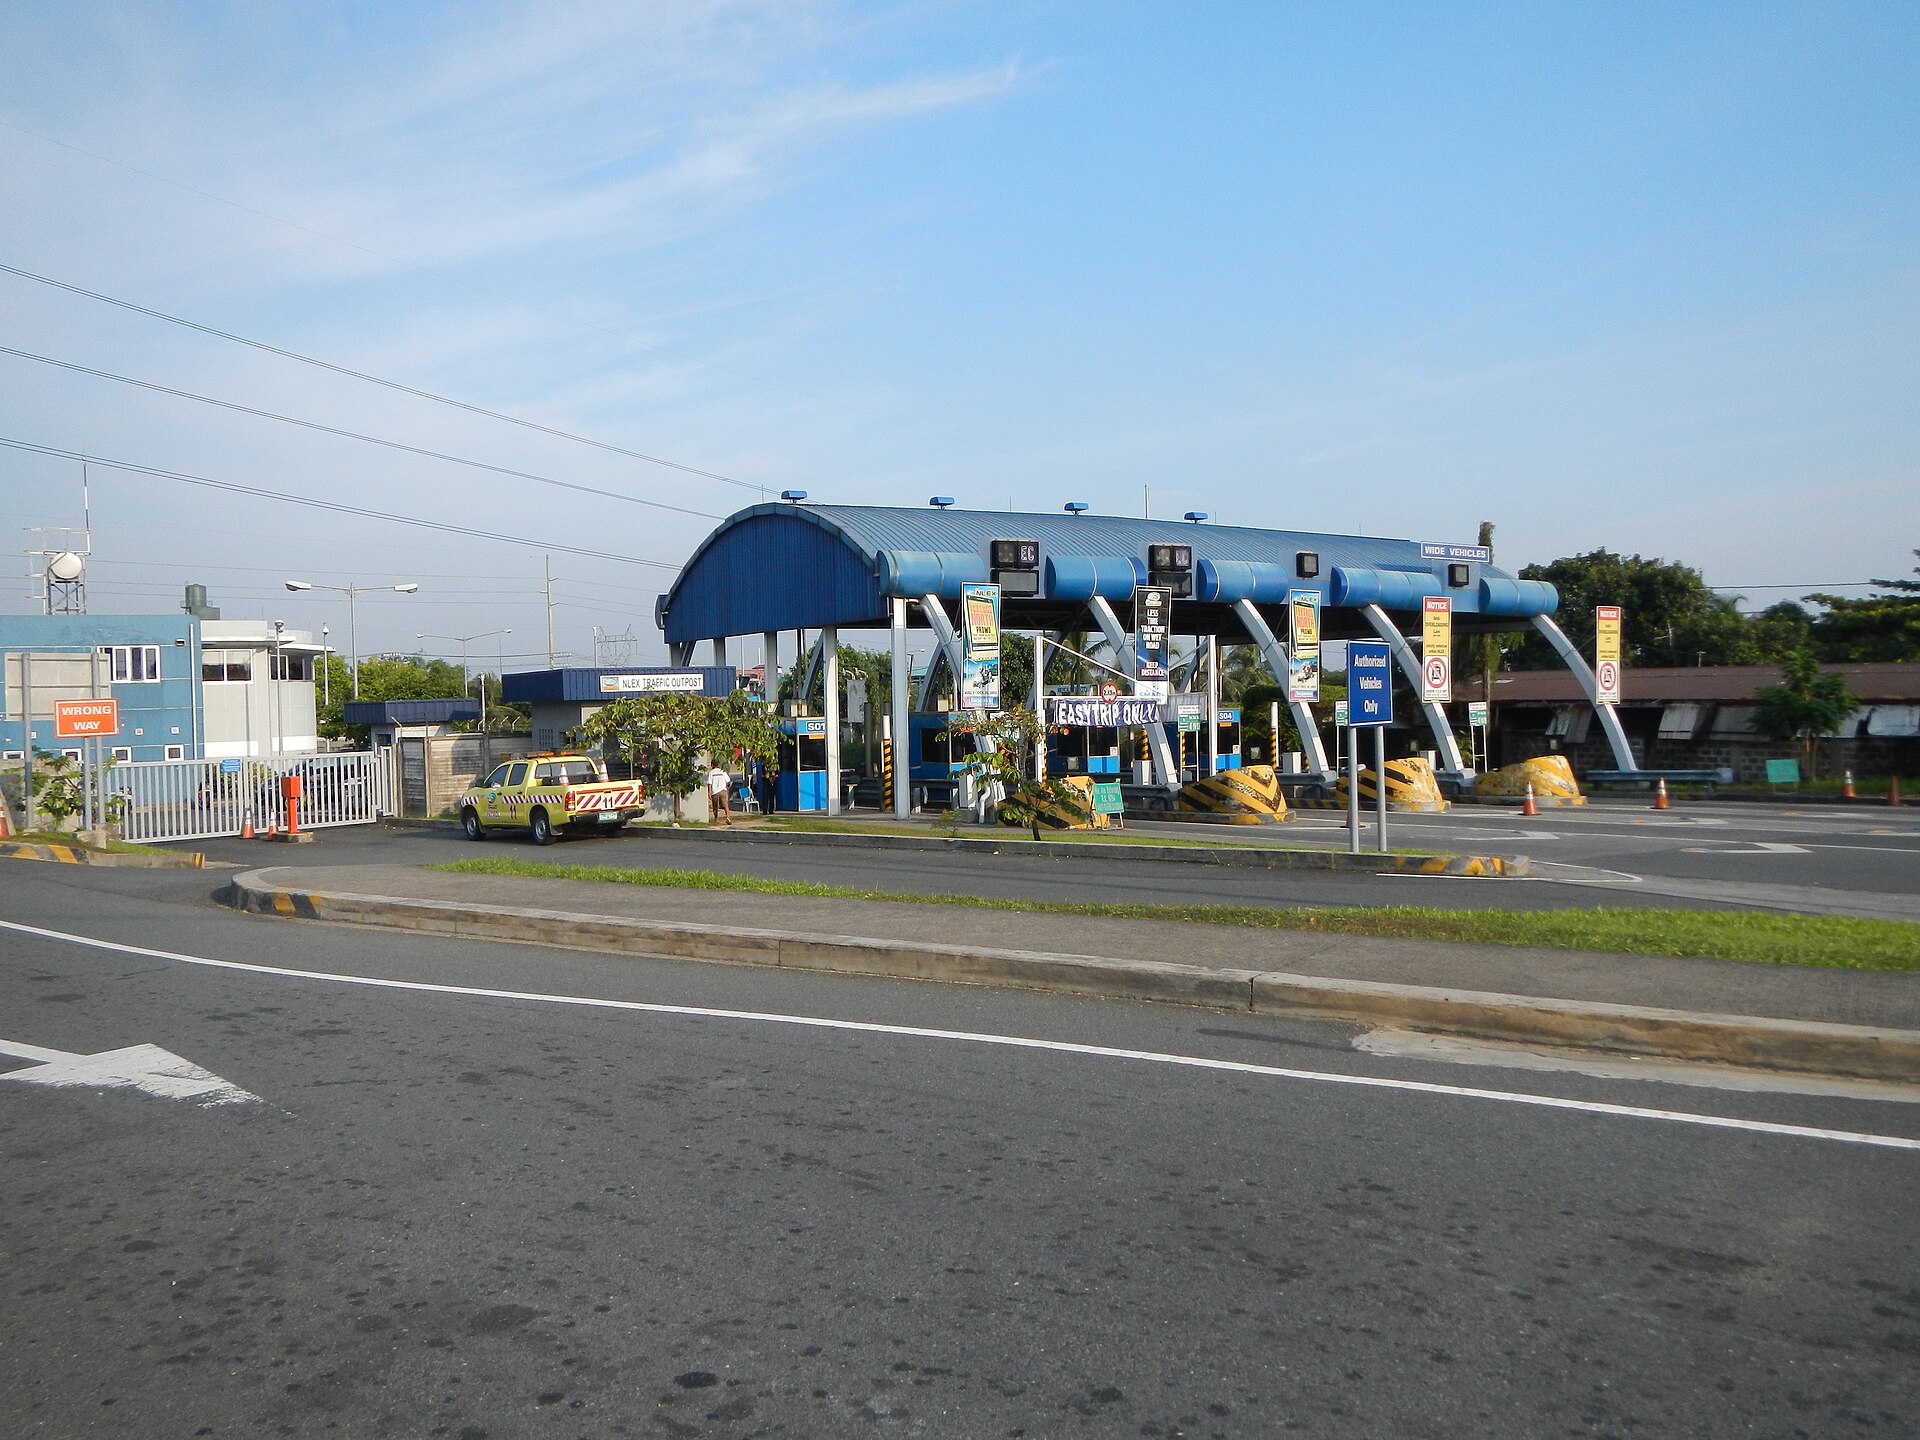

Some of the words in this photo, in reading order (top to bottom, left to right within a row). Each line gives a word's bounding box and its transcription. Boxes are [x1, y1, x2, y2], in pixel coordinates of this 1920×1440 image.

[1021, 545, 1035, 561] EC
[1424, 546, 1445, 555] WIDE
[1449, 548, 1486, 558] VEHICLES
[1426, 601, 1448, 610] NOTICE
[1147, 609, 1159, 617] LESS
[1141, 625, 1165, 633] TRACTION
[1143, 633, 1151, 641] ON
[1151, 633, 1162, 641] WET
[1146, 661, 1159, 669] KEEP
[1354, 654, 1387, 667] Authorized
[1141, 668, 1165, 677] DISTANCE
[622, 679, 640, 688] NLEX
[642, 678, 670, 688] TRAFFIC
[671, 677, 702, 687] OUTPOST
[1359, 676, 1382, 689] Vehicles
[62, 705, 112, 715] WRONG
[1364, 699, 1378, 715] Only
[1058, 702, 1120, 726] EASYTRIP
[1123, 702, 1155, 725] ONLY
[1219, 712, 1233, 720] S04
[73, 721, 101, 731] WAY
[808, 722, 825, 730] S01
[603, 797, 613, 809] 11
